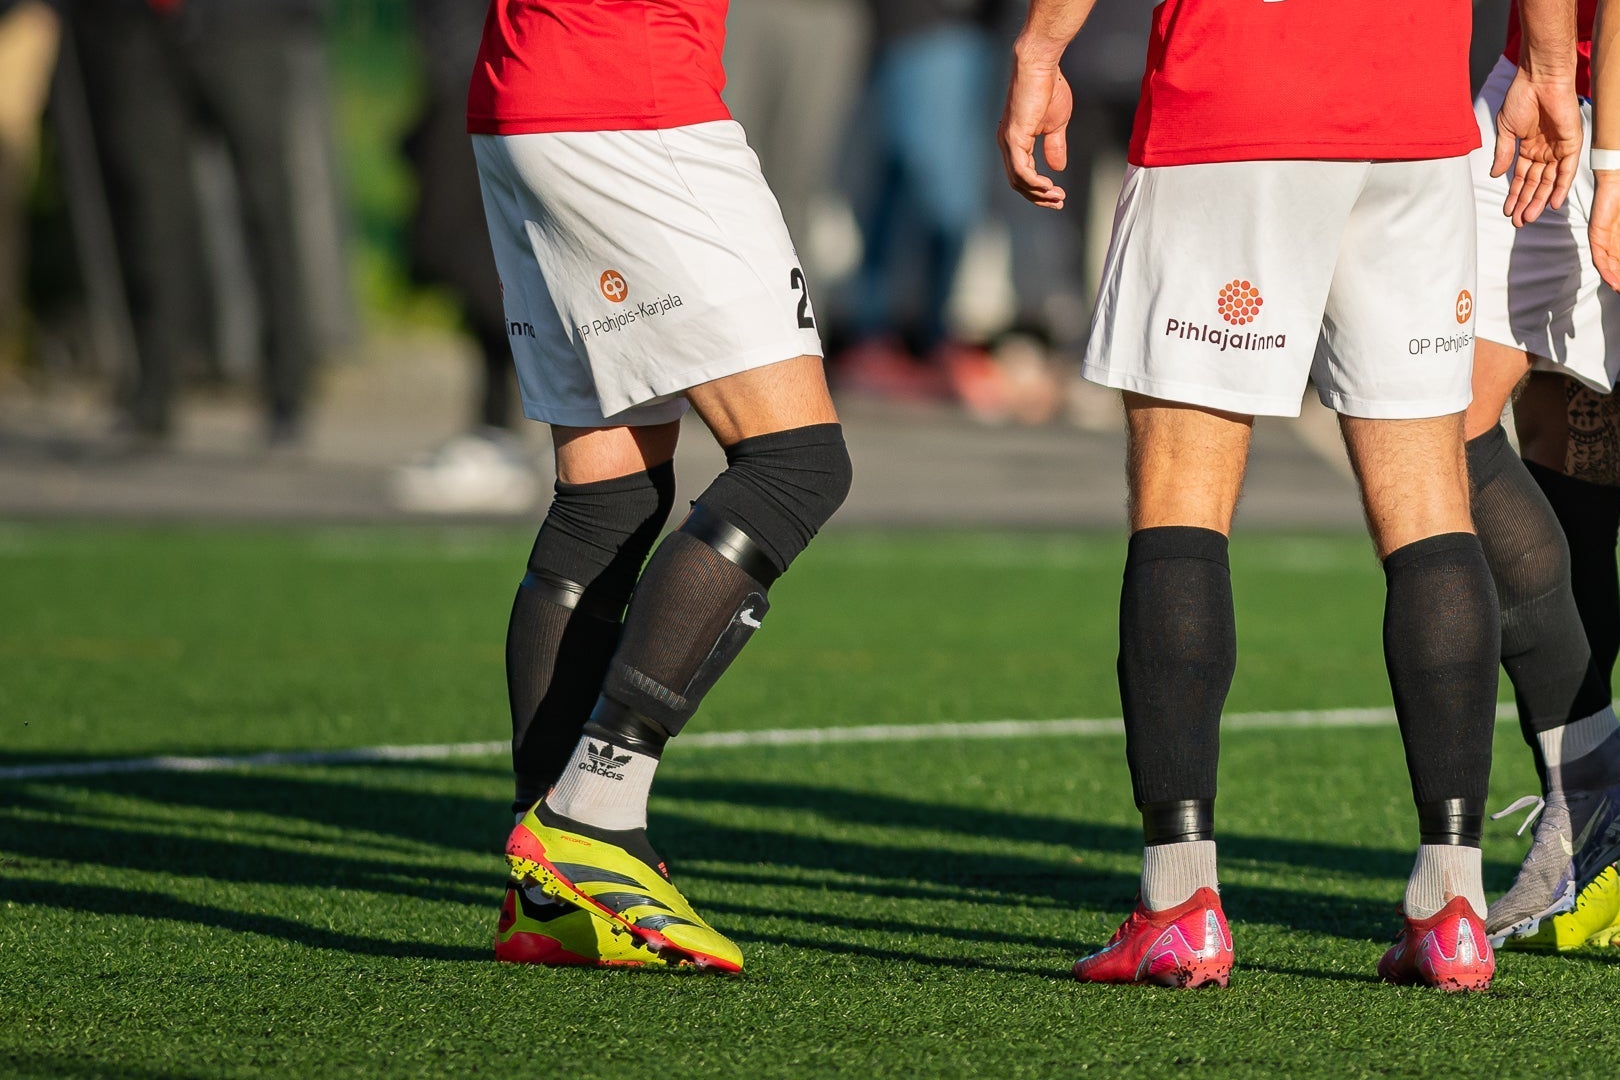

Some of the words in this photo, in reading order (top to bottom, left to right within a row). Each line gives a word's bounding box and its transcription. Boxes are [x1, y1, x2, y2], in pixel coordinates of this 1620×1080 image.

[592, 293, 683, 336] Pohjois-Karjala
[1165, 318, 1287, 352] Pihlajalinna
[1408, 338, 1431, 355] OP
[1435, 330, 1473, 353] Pohjois-
[578, 761, 625, 781] adidas
